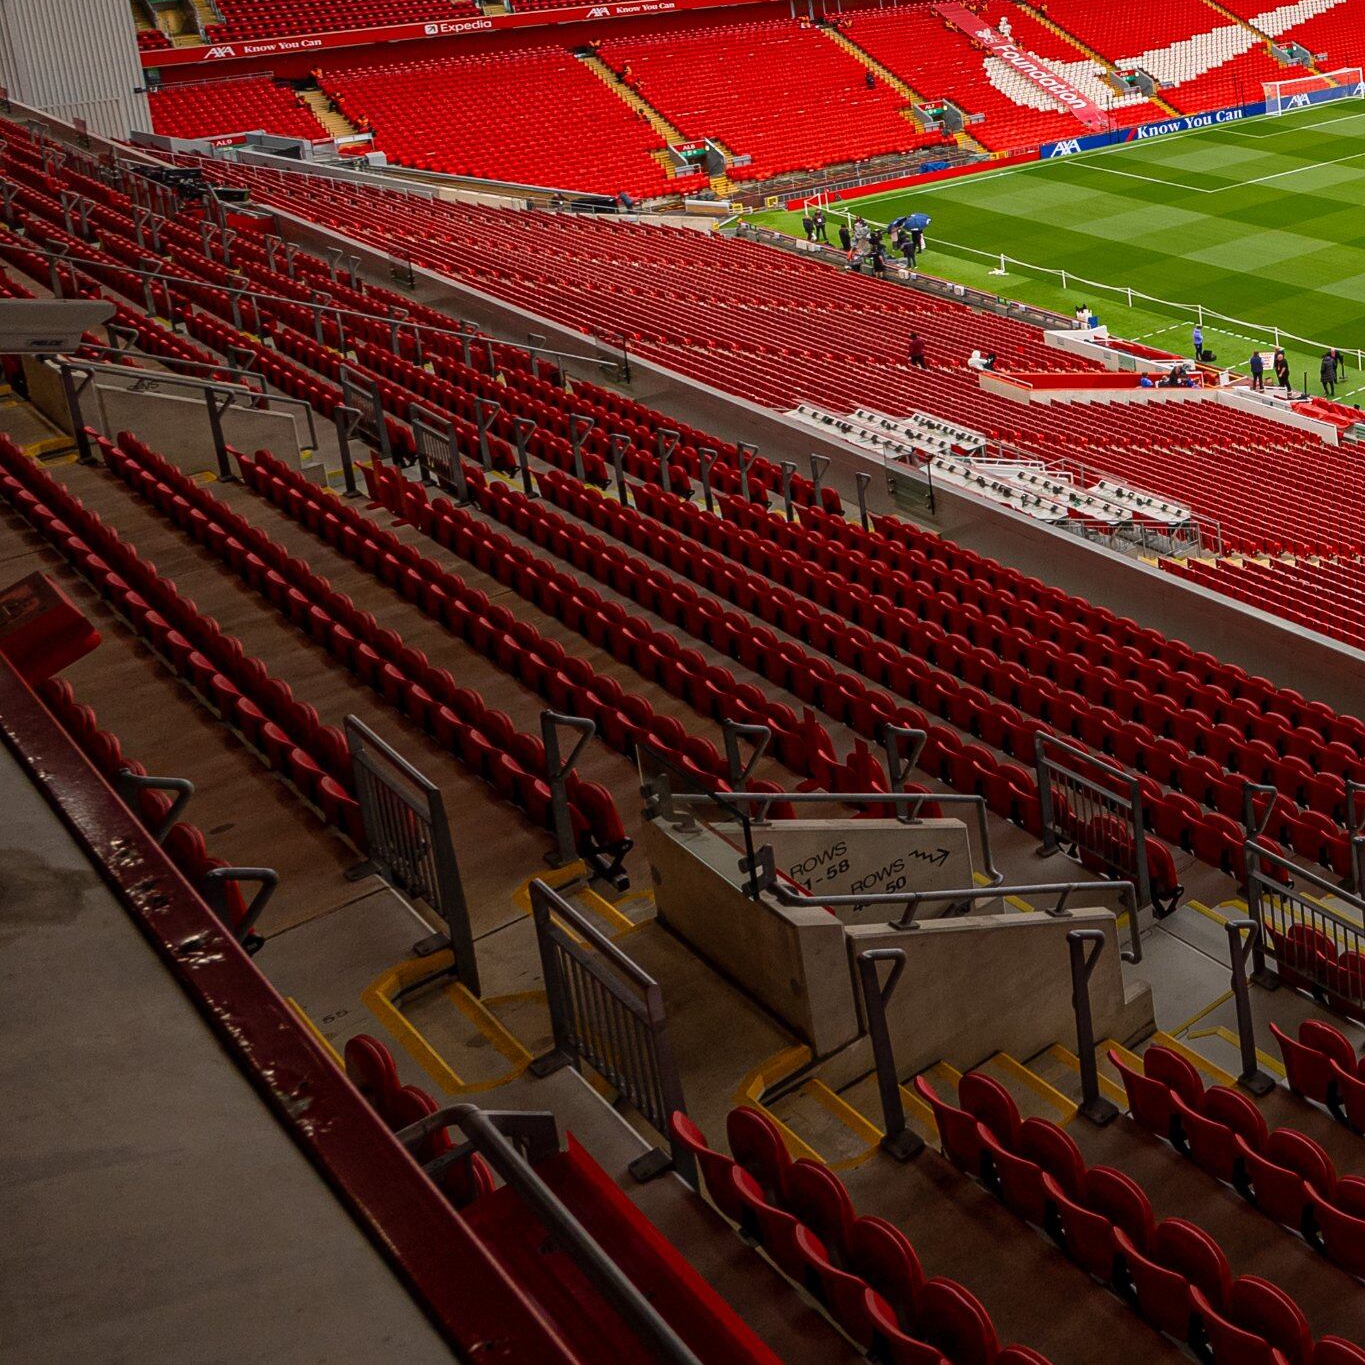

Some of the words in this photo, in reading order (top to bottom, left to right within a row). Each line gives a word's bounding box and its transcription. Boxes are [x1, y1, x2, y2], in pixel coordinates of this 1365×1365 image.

[586, 7, 611, 19] AXA
[616, 5, 640, 14] Know
[641, 4, 659, 12] You
[660, 1, 675, 9] Can
[440, 19, 492, 34] Expedia
[203, 46, 236, 59] AXA
[244, 44, 276, 54] Know
[278, 41, 300, 50] You
[301, 38, 322, 47] Can
[993, 45, 1087, 109] Foundation
[1285, 94, 1312, 109] AXA
[1137, 121, 1180, 140] Know
[1184, 115, 1212, 130] You
[1216, 109, 1243, 123] Can
[1051, 139, 1082, 158] AXA
[790, 841, 848, 880] ROWS
[826, 859, 850, 880] 58
[851, 858, 905, 895] ROWS
[886, 876, 907, 894] 50
